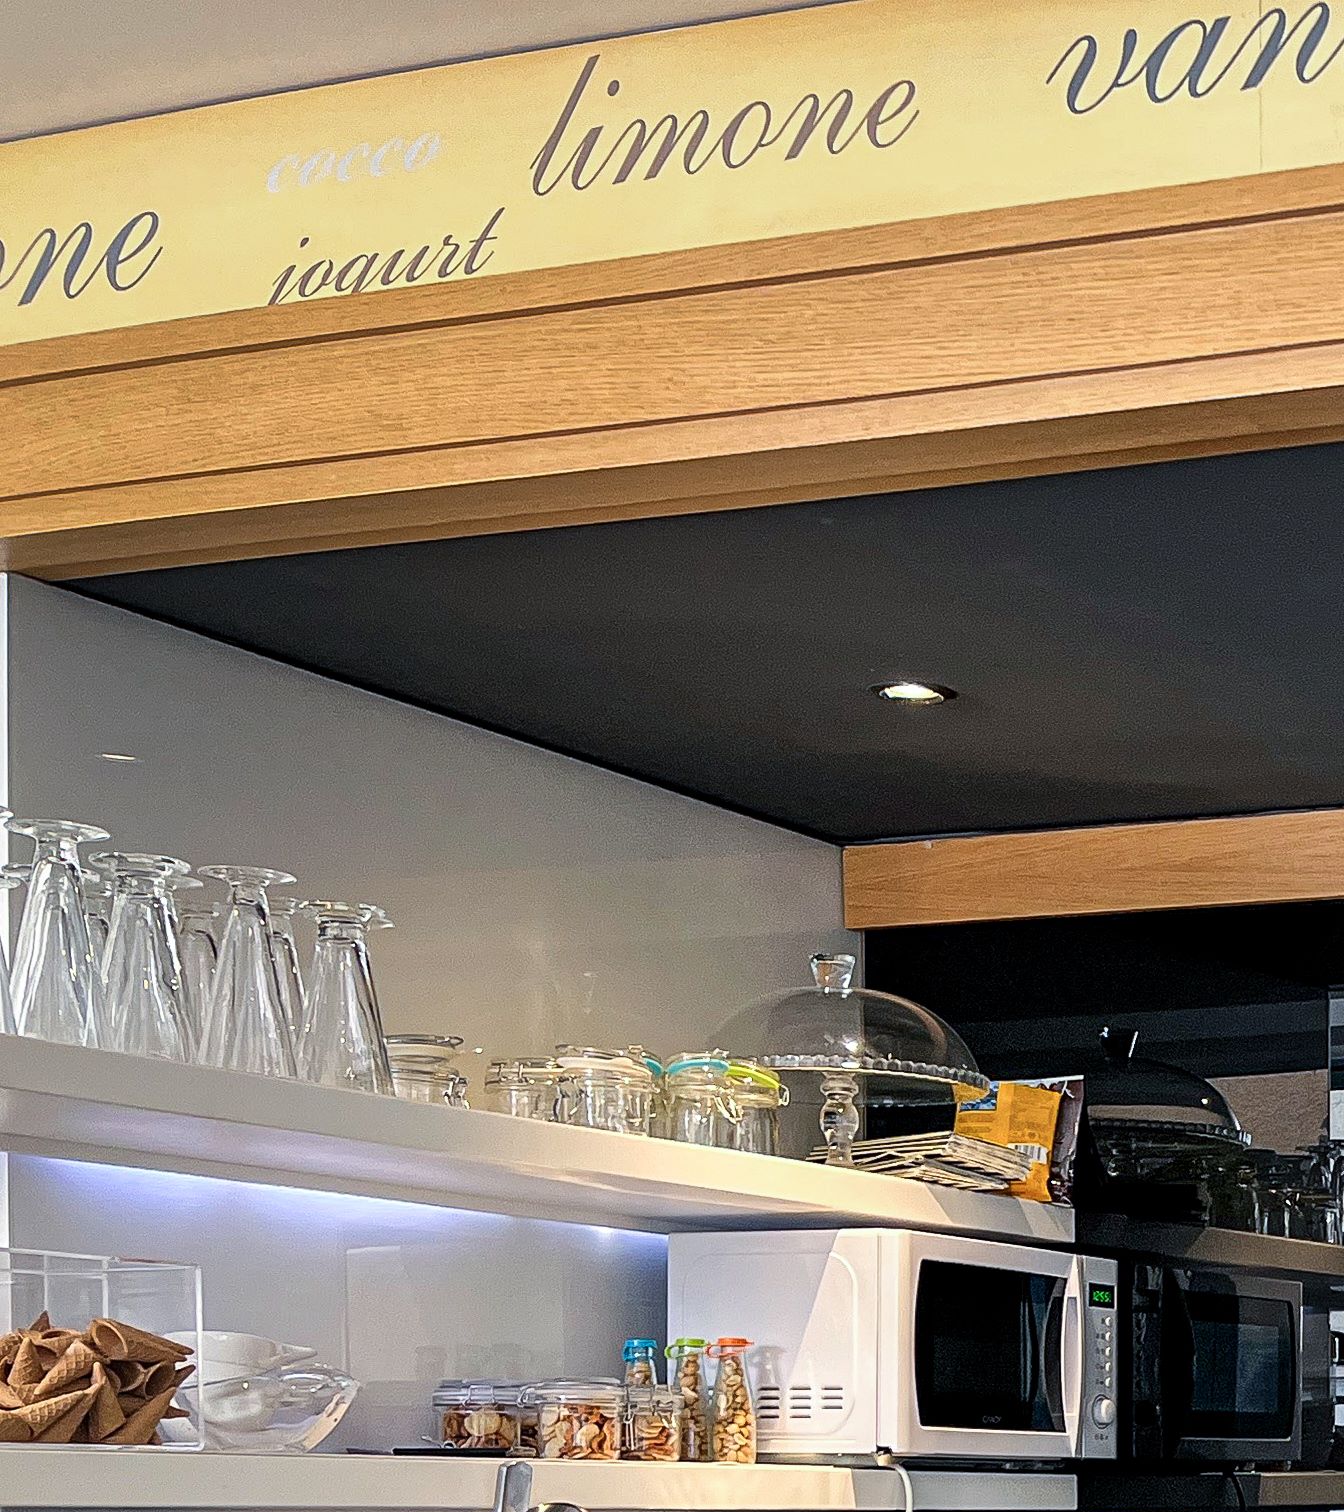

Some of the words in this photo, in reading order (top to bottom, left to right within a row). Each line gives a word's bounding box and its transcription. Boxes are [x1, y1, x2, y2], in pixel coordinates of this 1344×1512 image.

[265, 130, 442, 194] cocco
[529, 54, 920, 196] limone
[0, 210, 164, 306] ne
